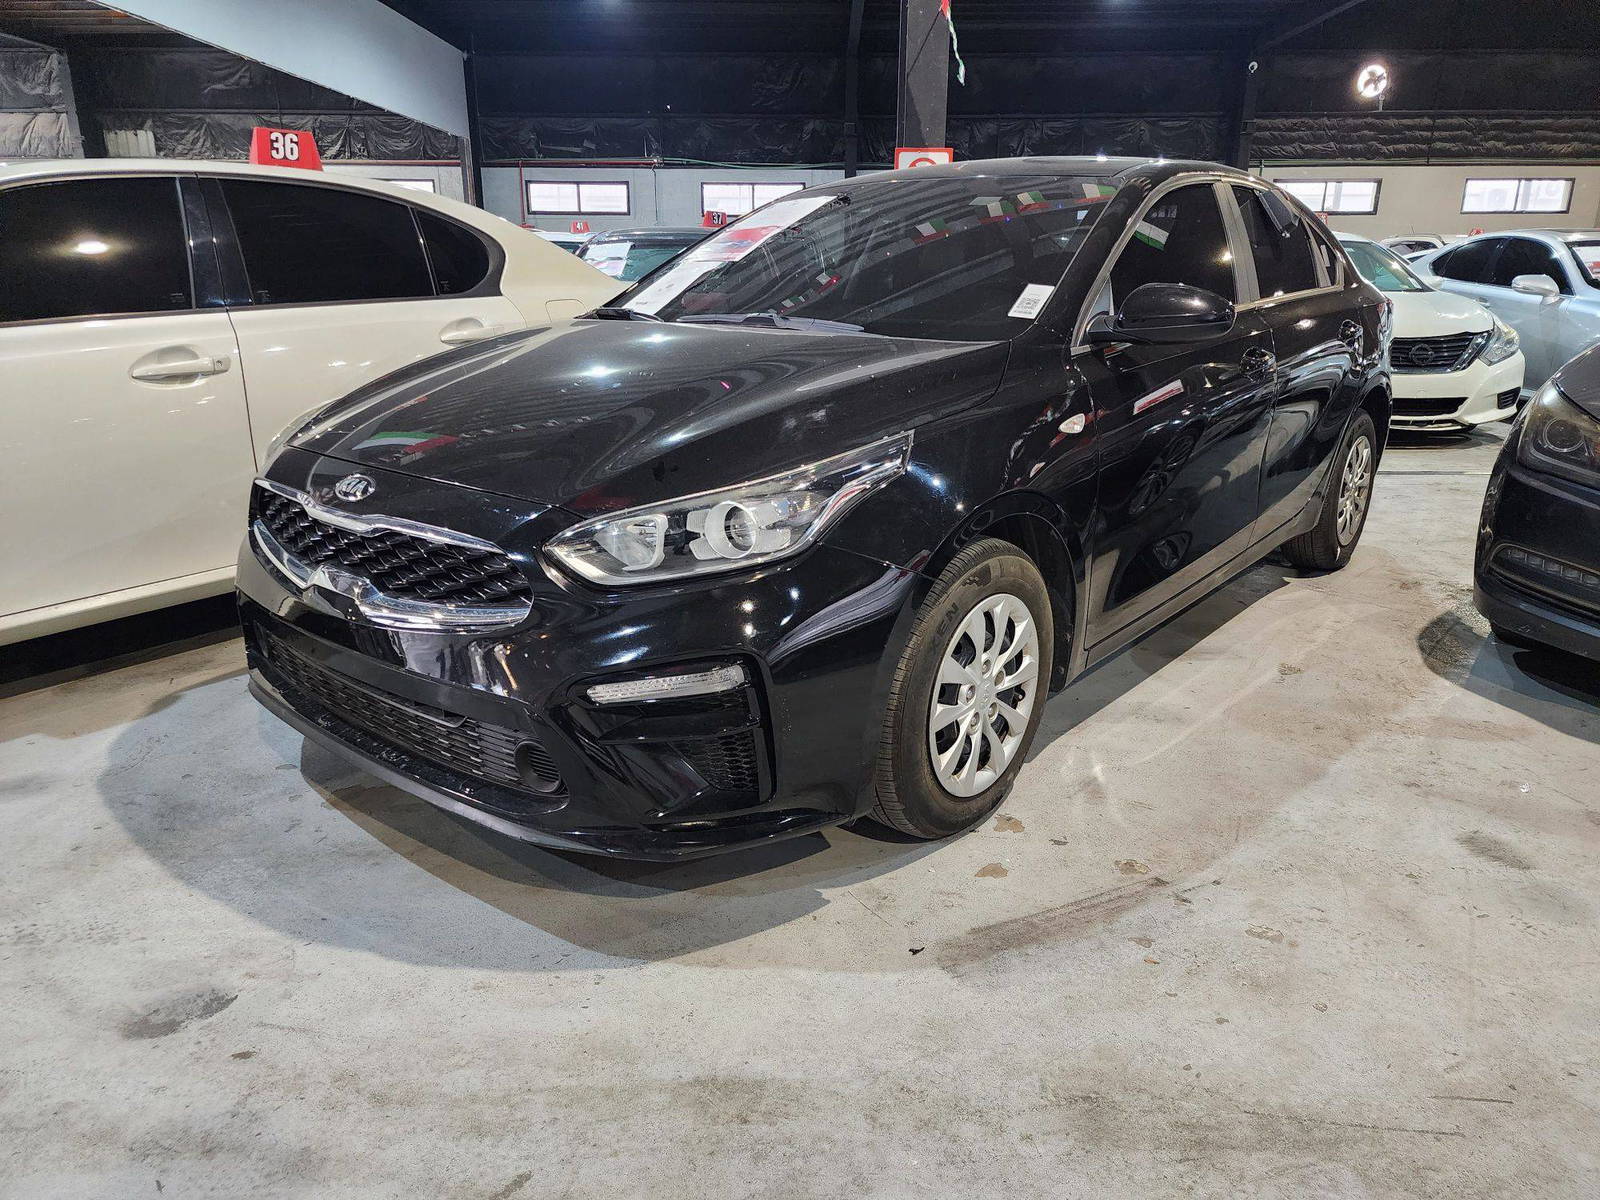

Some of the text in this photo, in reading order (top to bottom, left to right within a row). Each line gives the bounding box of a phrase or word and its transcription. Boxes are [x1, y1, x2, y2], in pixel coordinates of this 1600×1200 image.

[270, 132, 299, 161] 36
[712, 212, 723, 225] 37
[338, 477, 371, 499] KIA
